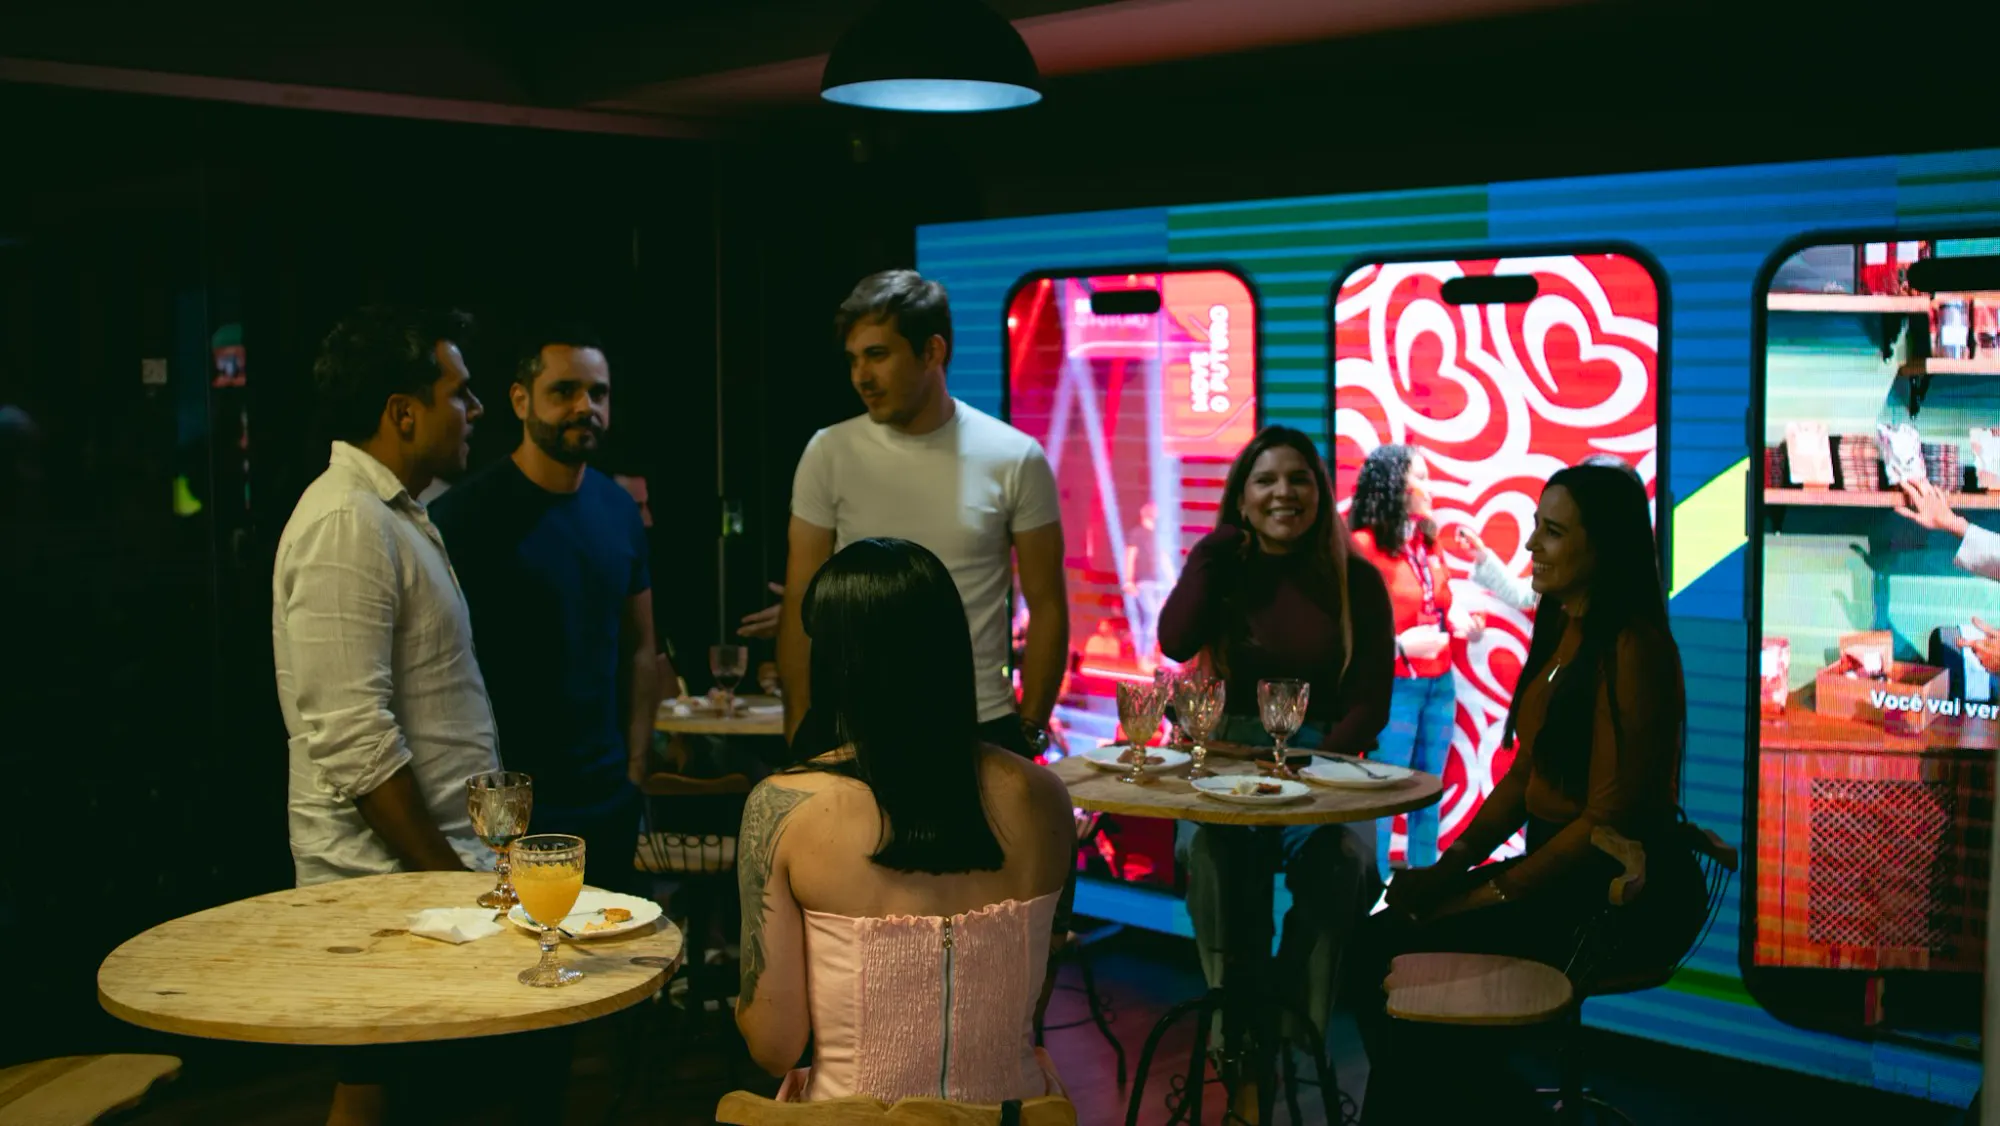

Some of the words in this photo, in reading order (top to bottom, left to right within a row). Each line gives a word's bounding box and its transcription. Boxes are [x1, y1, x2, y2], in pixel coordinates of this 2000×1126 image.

[1870, 688, 1924, 713] Você
[1927, 697, 1960, 717] vai
[1964, 702, 2000, 720] ver
